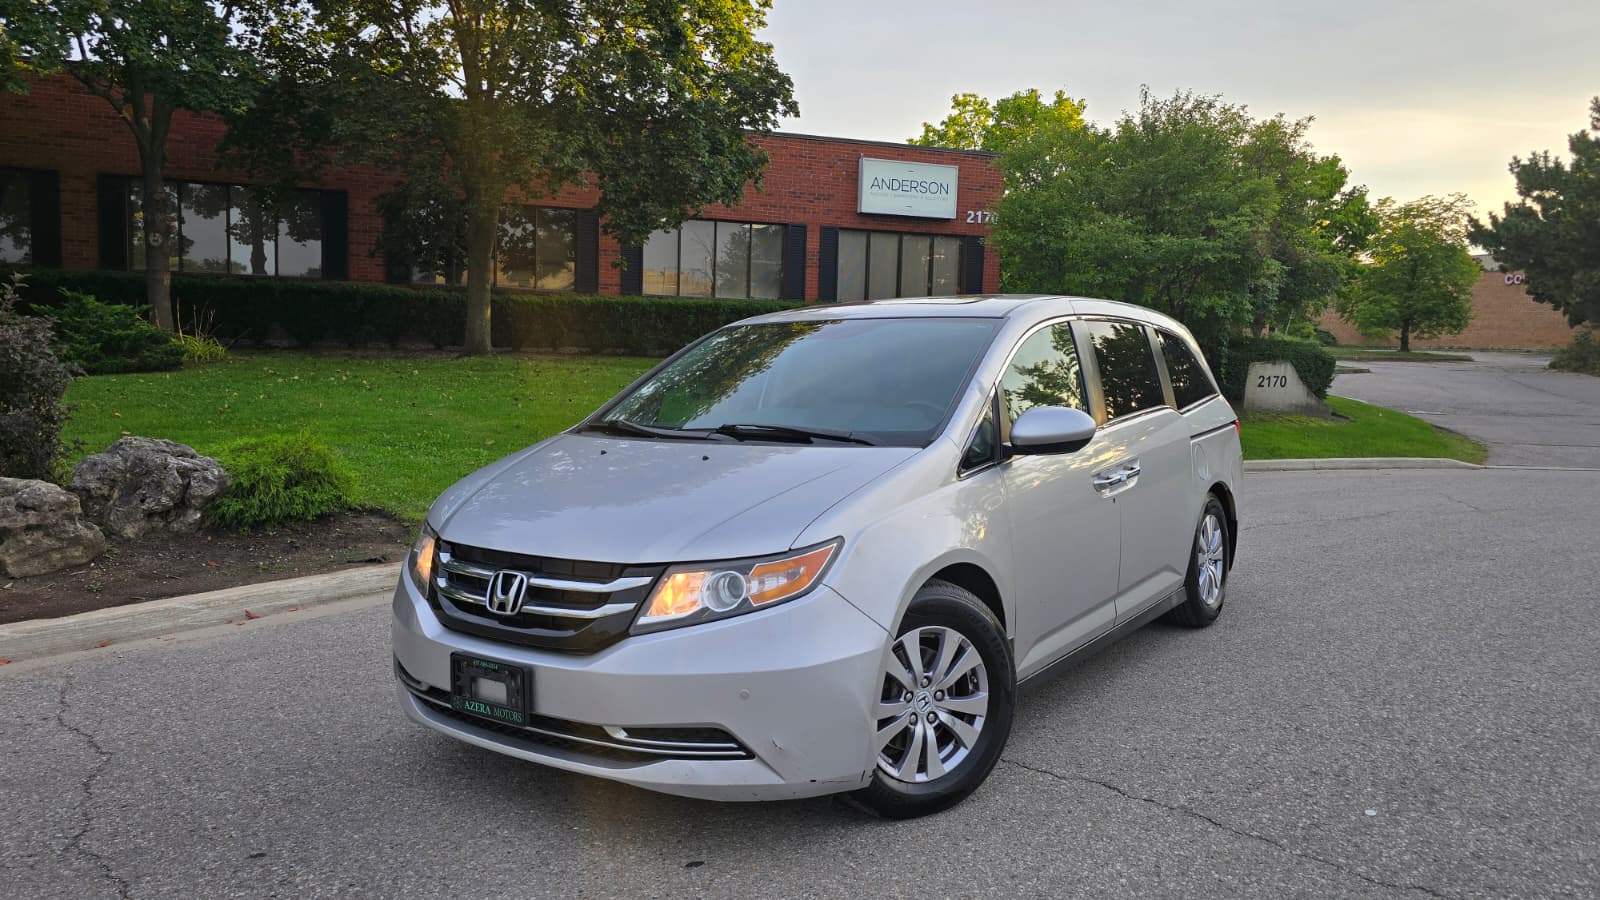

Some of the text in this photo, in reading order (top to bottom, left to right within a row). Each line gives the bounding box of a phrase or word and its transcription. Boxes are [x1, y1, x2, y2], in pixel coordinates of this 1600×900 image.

[870, 176, 949, 195] ANDERSON
[1257, 375, 1288, 388] 2170
[464, 700, 522, 722] AZERA MOTORS
